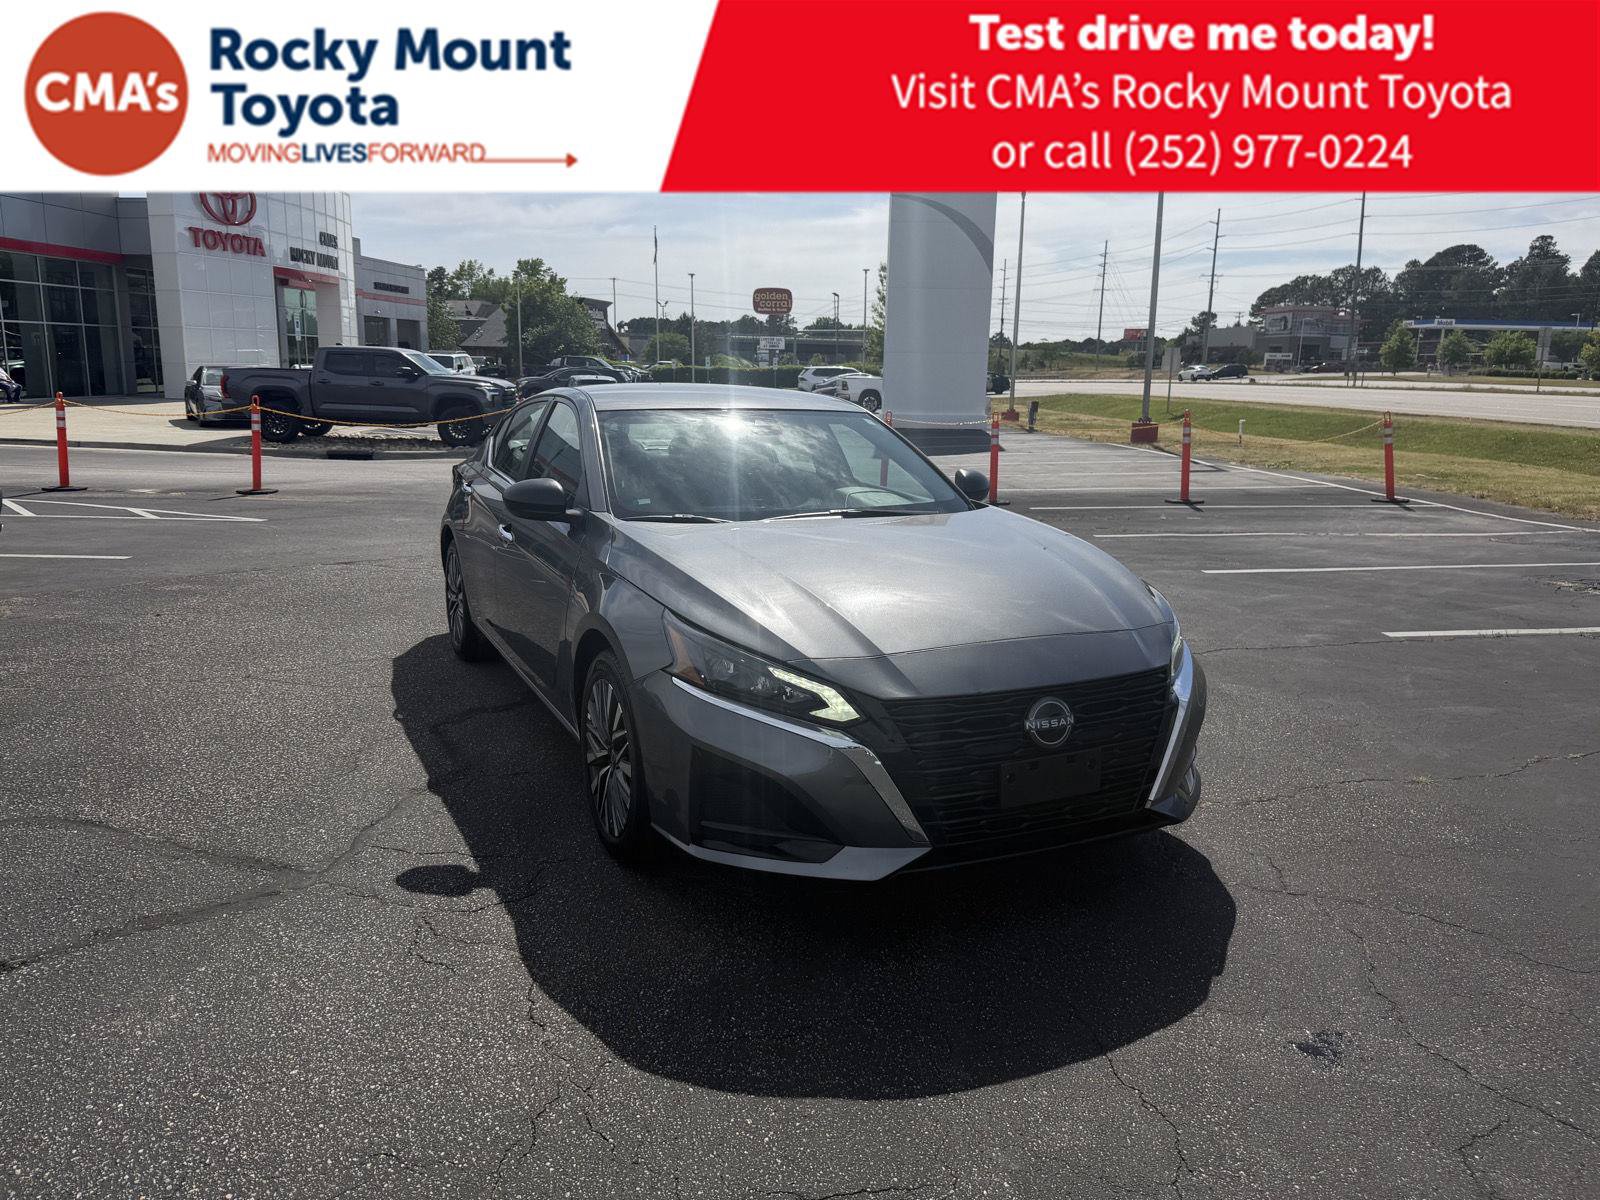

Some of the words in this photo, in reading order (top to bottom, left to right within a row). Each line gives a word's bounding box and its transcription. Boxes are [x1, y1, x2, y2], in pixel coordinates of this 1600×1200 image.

[189, 226, 266, 257] TOYOTA
[754, 292, 788, 302] golden
[760, 300, 792, 308] corral
[1026, 714, 1074, 730] NISSAN
